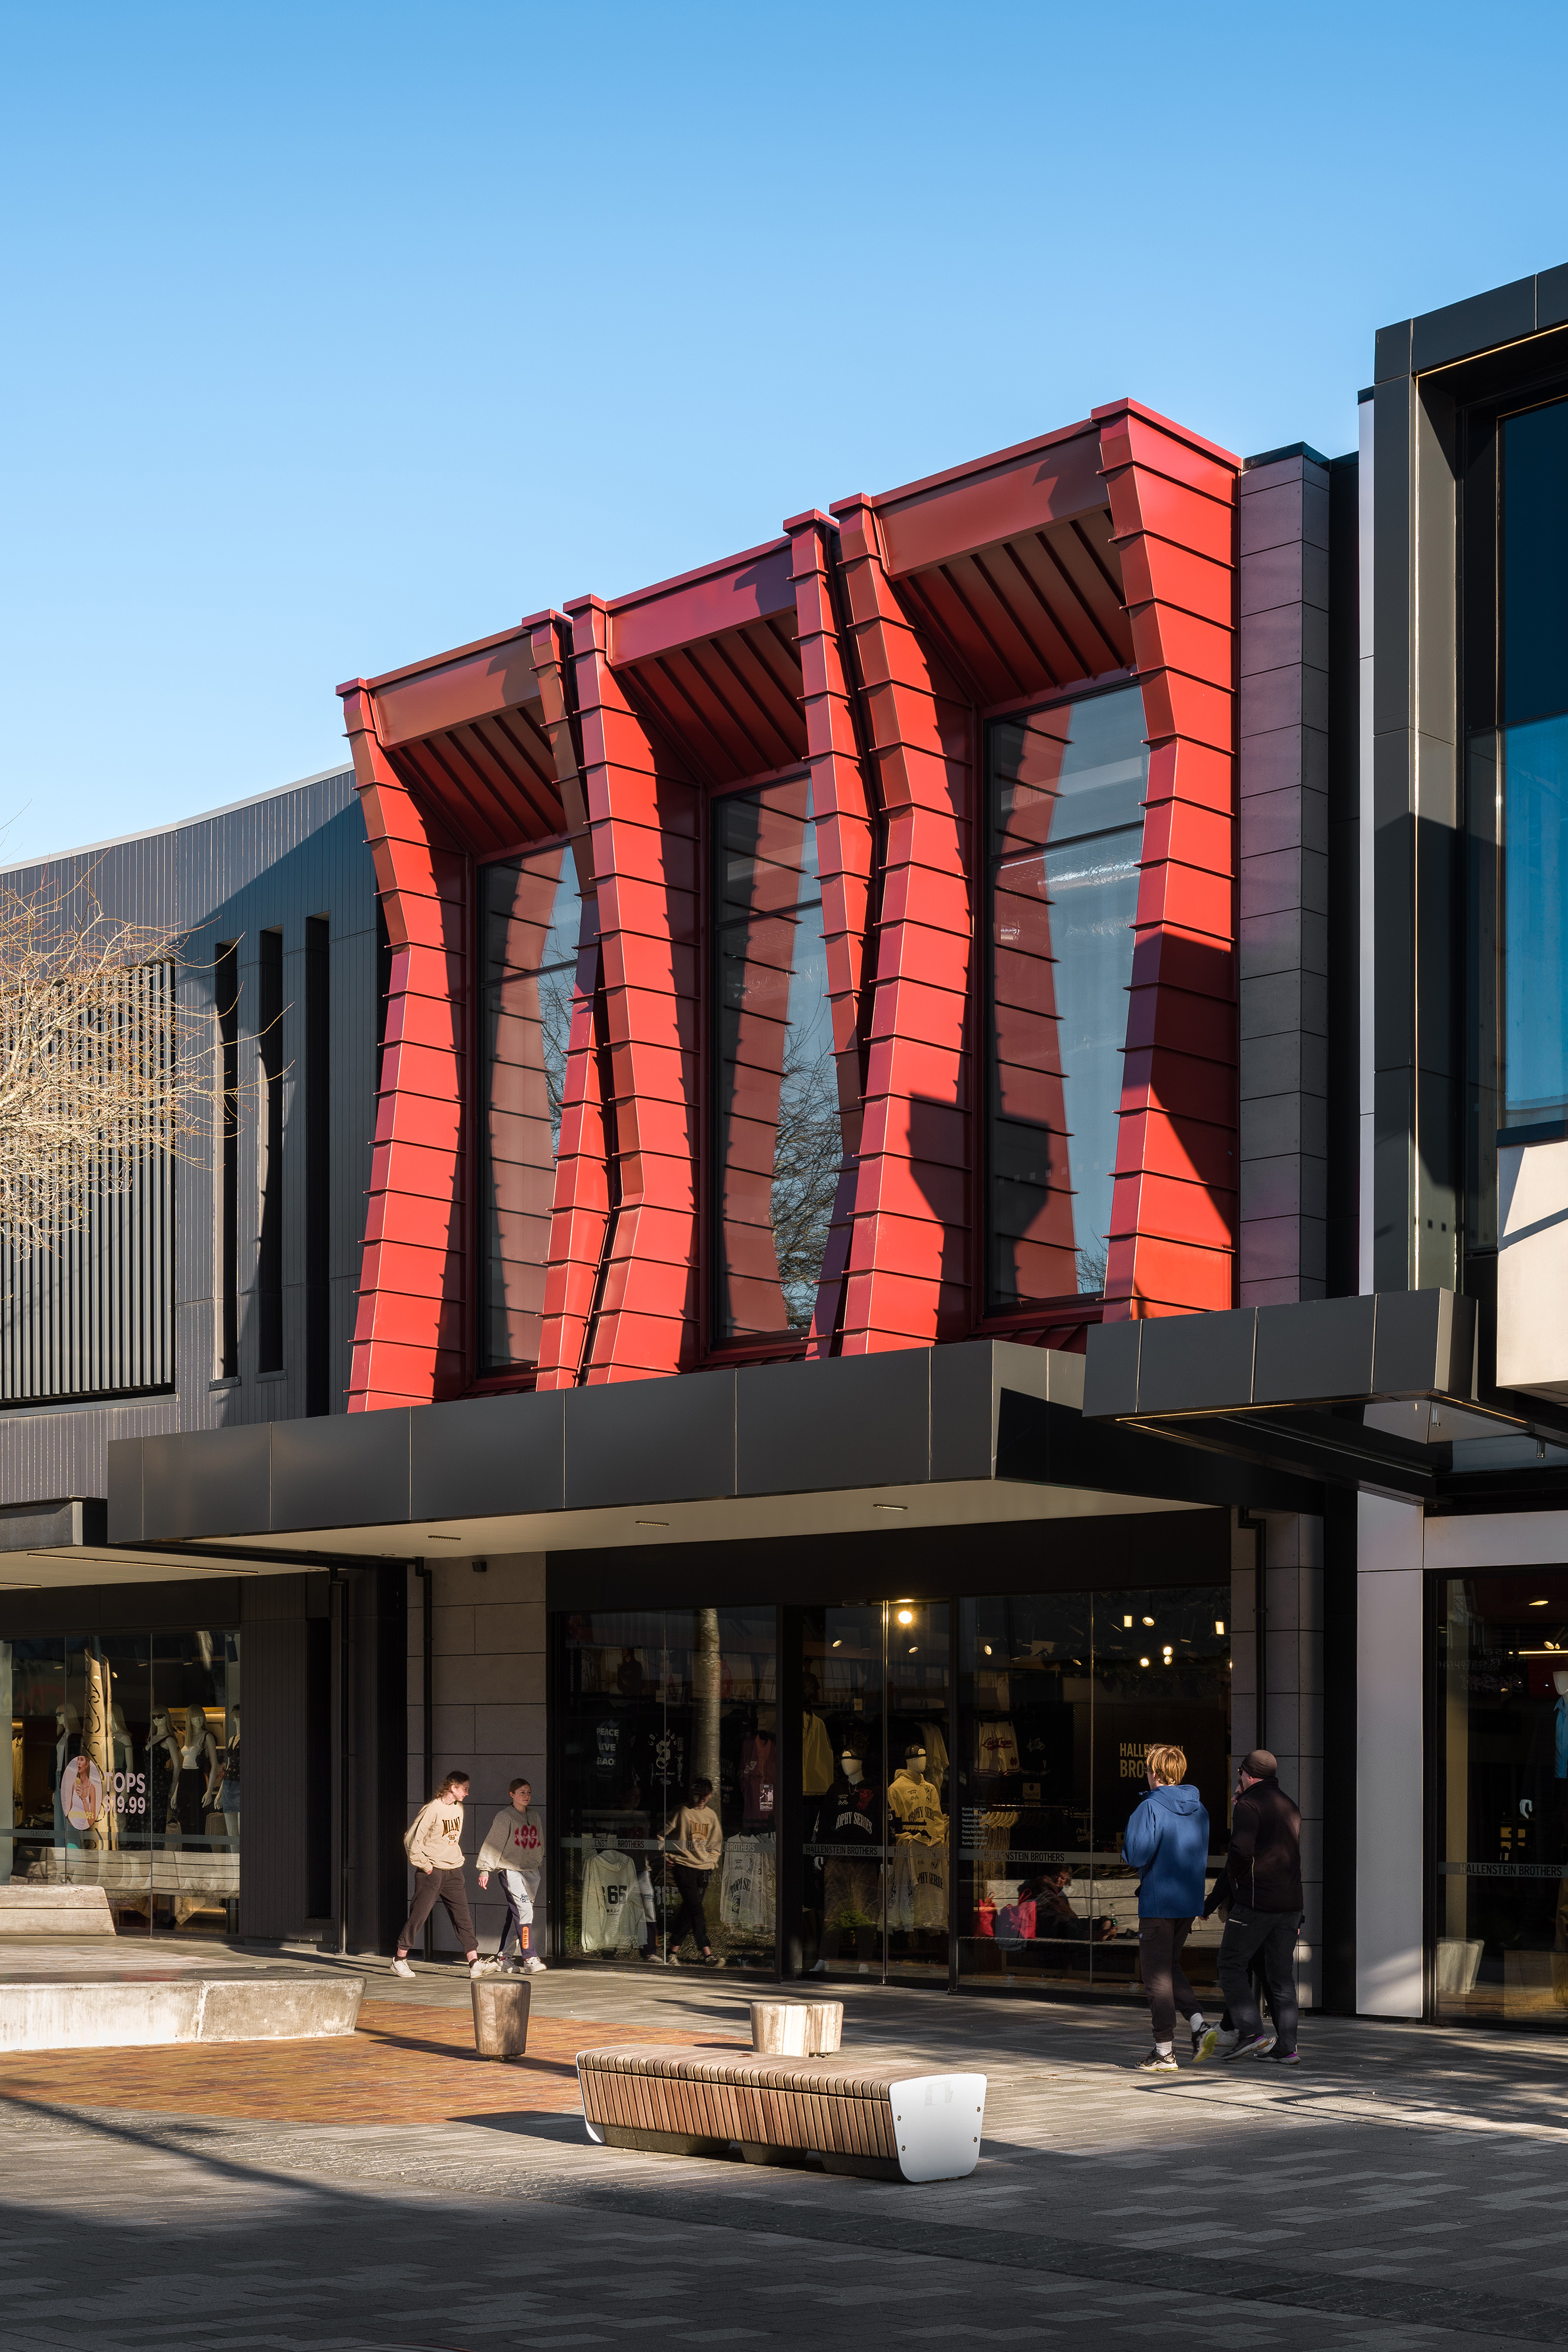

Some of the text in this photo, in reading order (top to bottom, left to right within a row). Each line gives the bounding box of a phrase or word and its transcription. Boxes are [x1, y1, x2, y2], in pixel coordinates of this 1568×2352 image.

[596, 1728, 620, 1736] PEACE
[599, 1743, 616, 1751] LOVE
[104, 1772, 146, 1793] TOPS
[103, 1795, 146, 1815] $19.99
[853, 1812, 872, 1835] SERIES
[617, 1840, 644, 1848] BROTHERS
[727, 1843, 755, 1852] BROTHERS
[806, 1845, 878, 1855] HALLENSTEIN BROTHERS
[1030, 1852, 1065, 1862] BROTHERS
[1460, 1863, 1562, 1876] HALLENSTEIN BROTHERS
